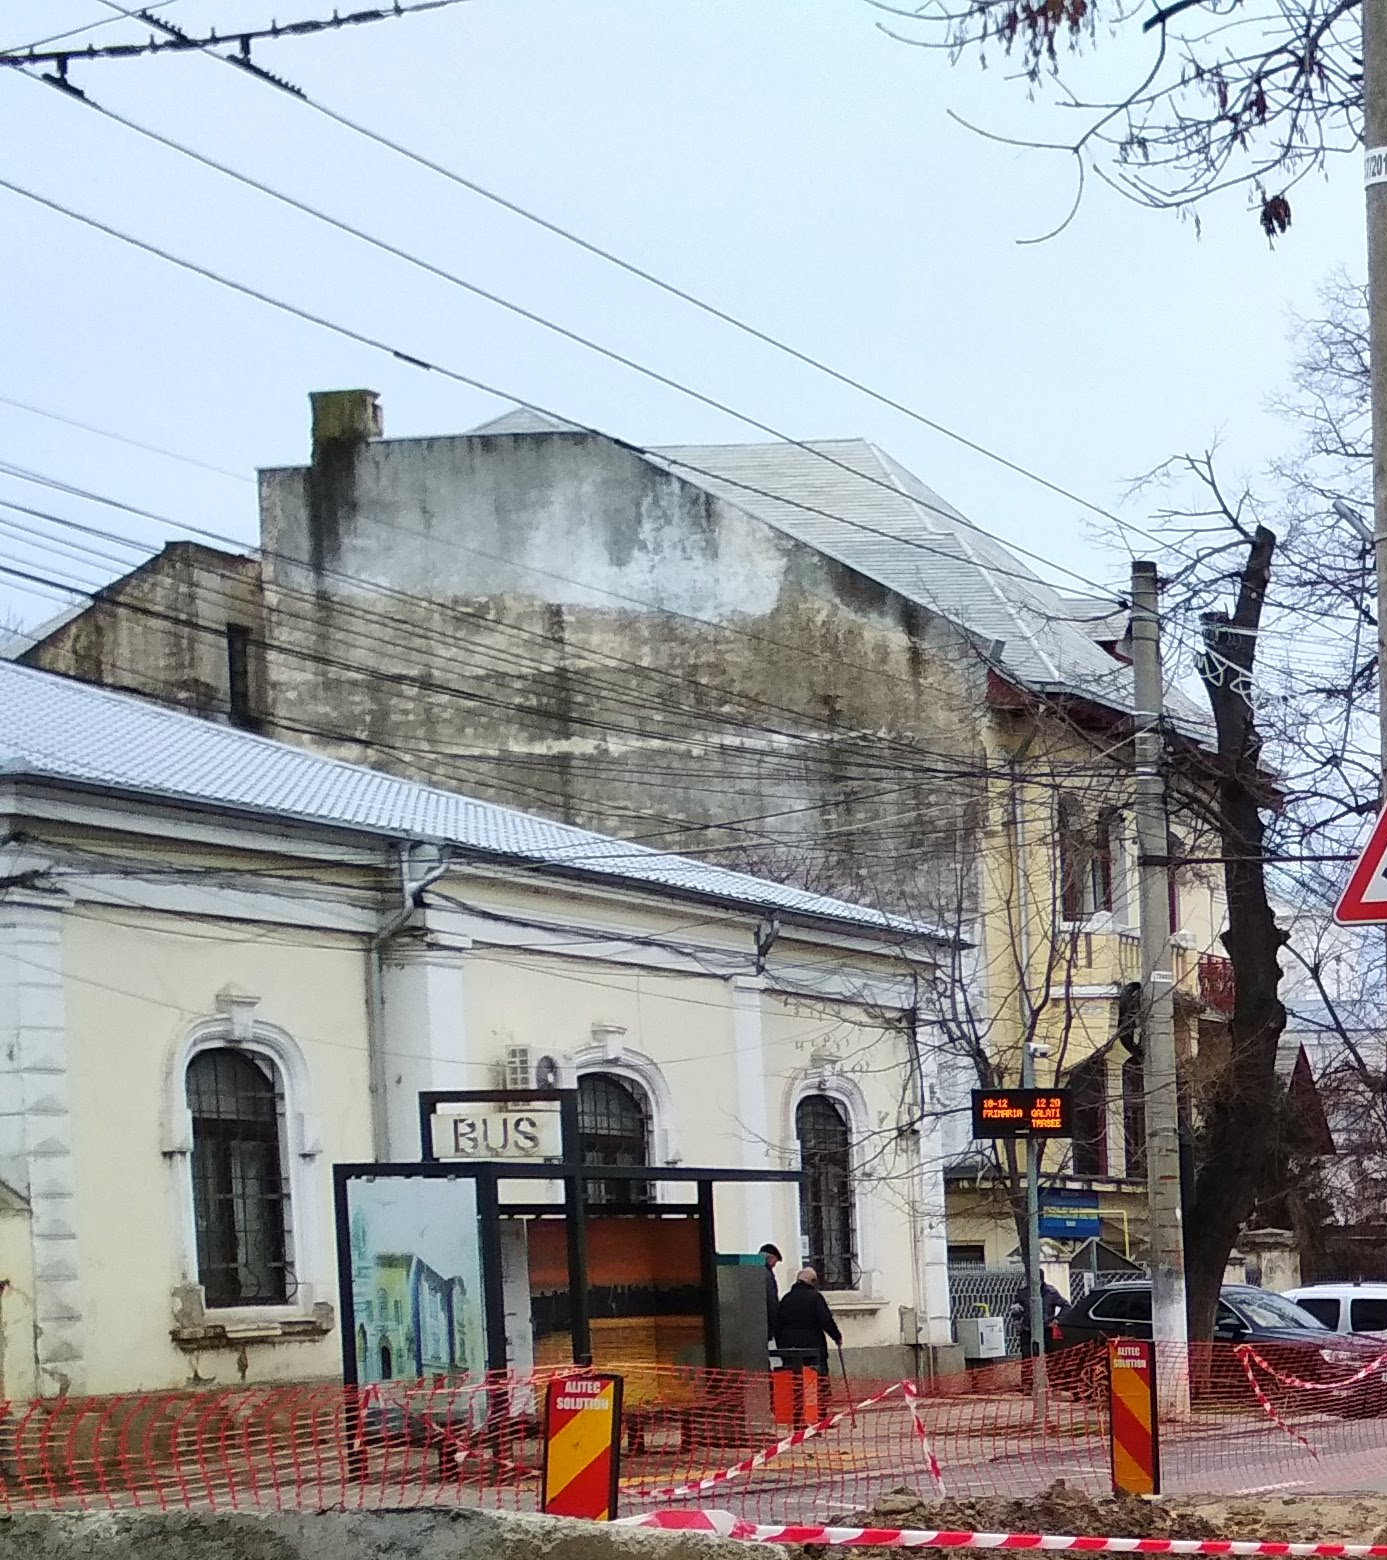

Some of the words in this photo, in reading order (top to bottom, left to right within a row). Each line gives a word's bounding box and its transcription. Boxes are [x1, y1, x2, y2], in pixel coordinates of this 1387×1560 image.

[1036, 1098, 1046, 1108] 12
[1030, 1109, 1061, 1118] GALATI
[452, 1116, 540, 1156] BUS
[564, 1380, 601, 1394] ALITEC
[556, 1396, 609, 1410] SOLUTION
